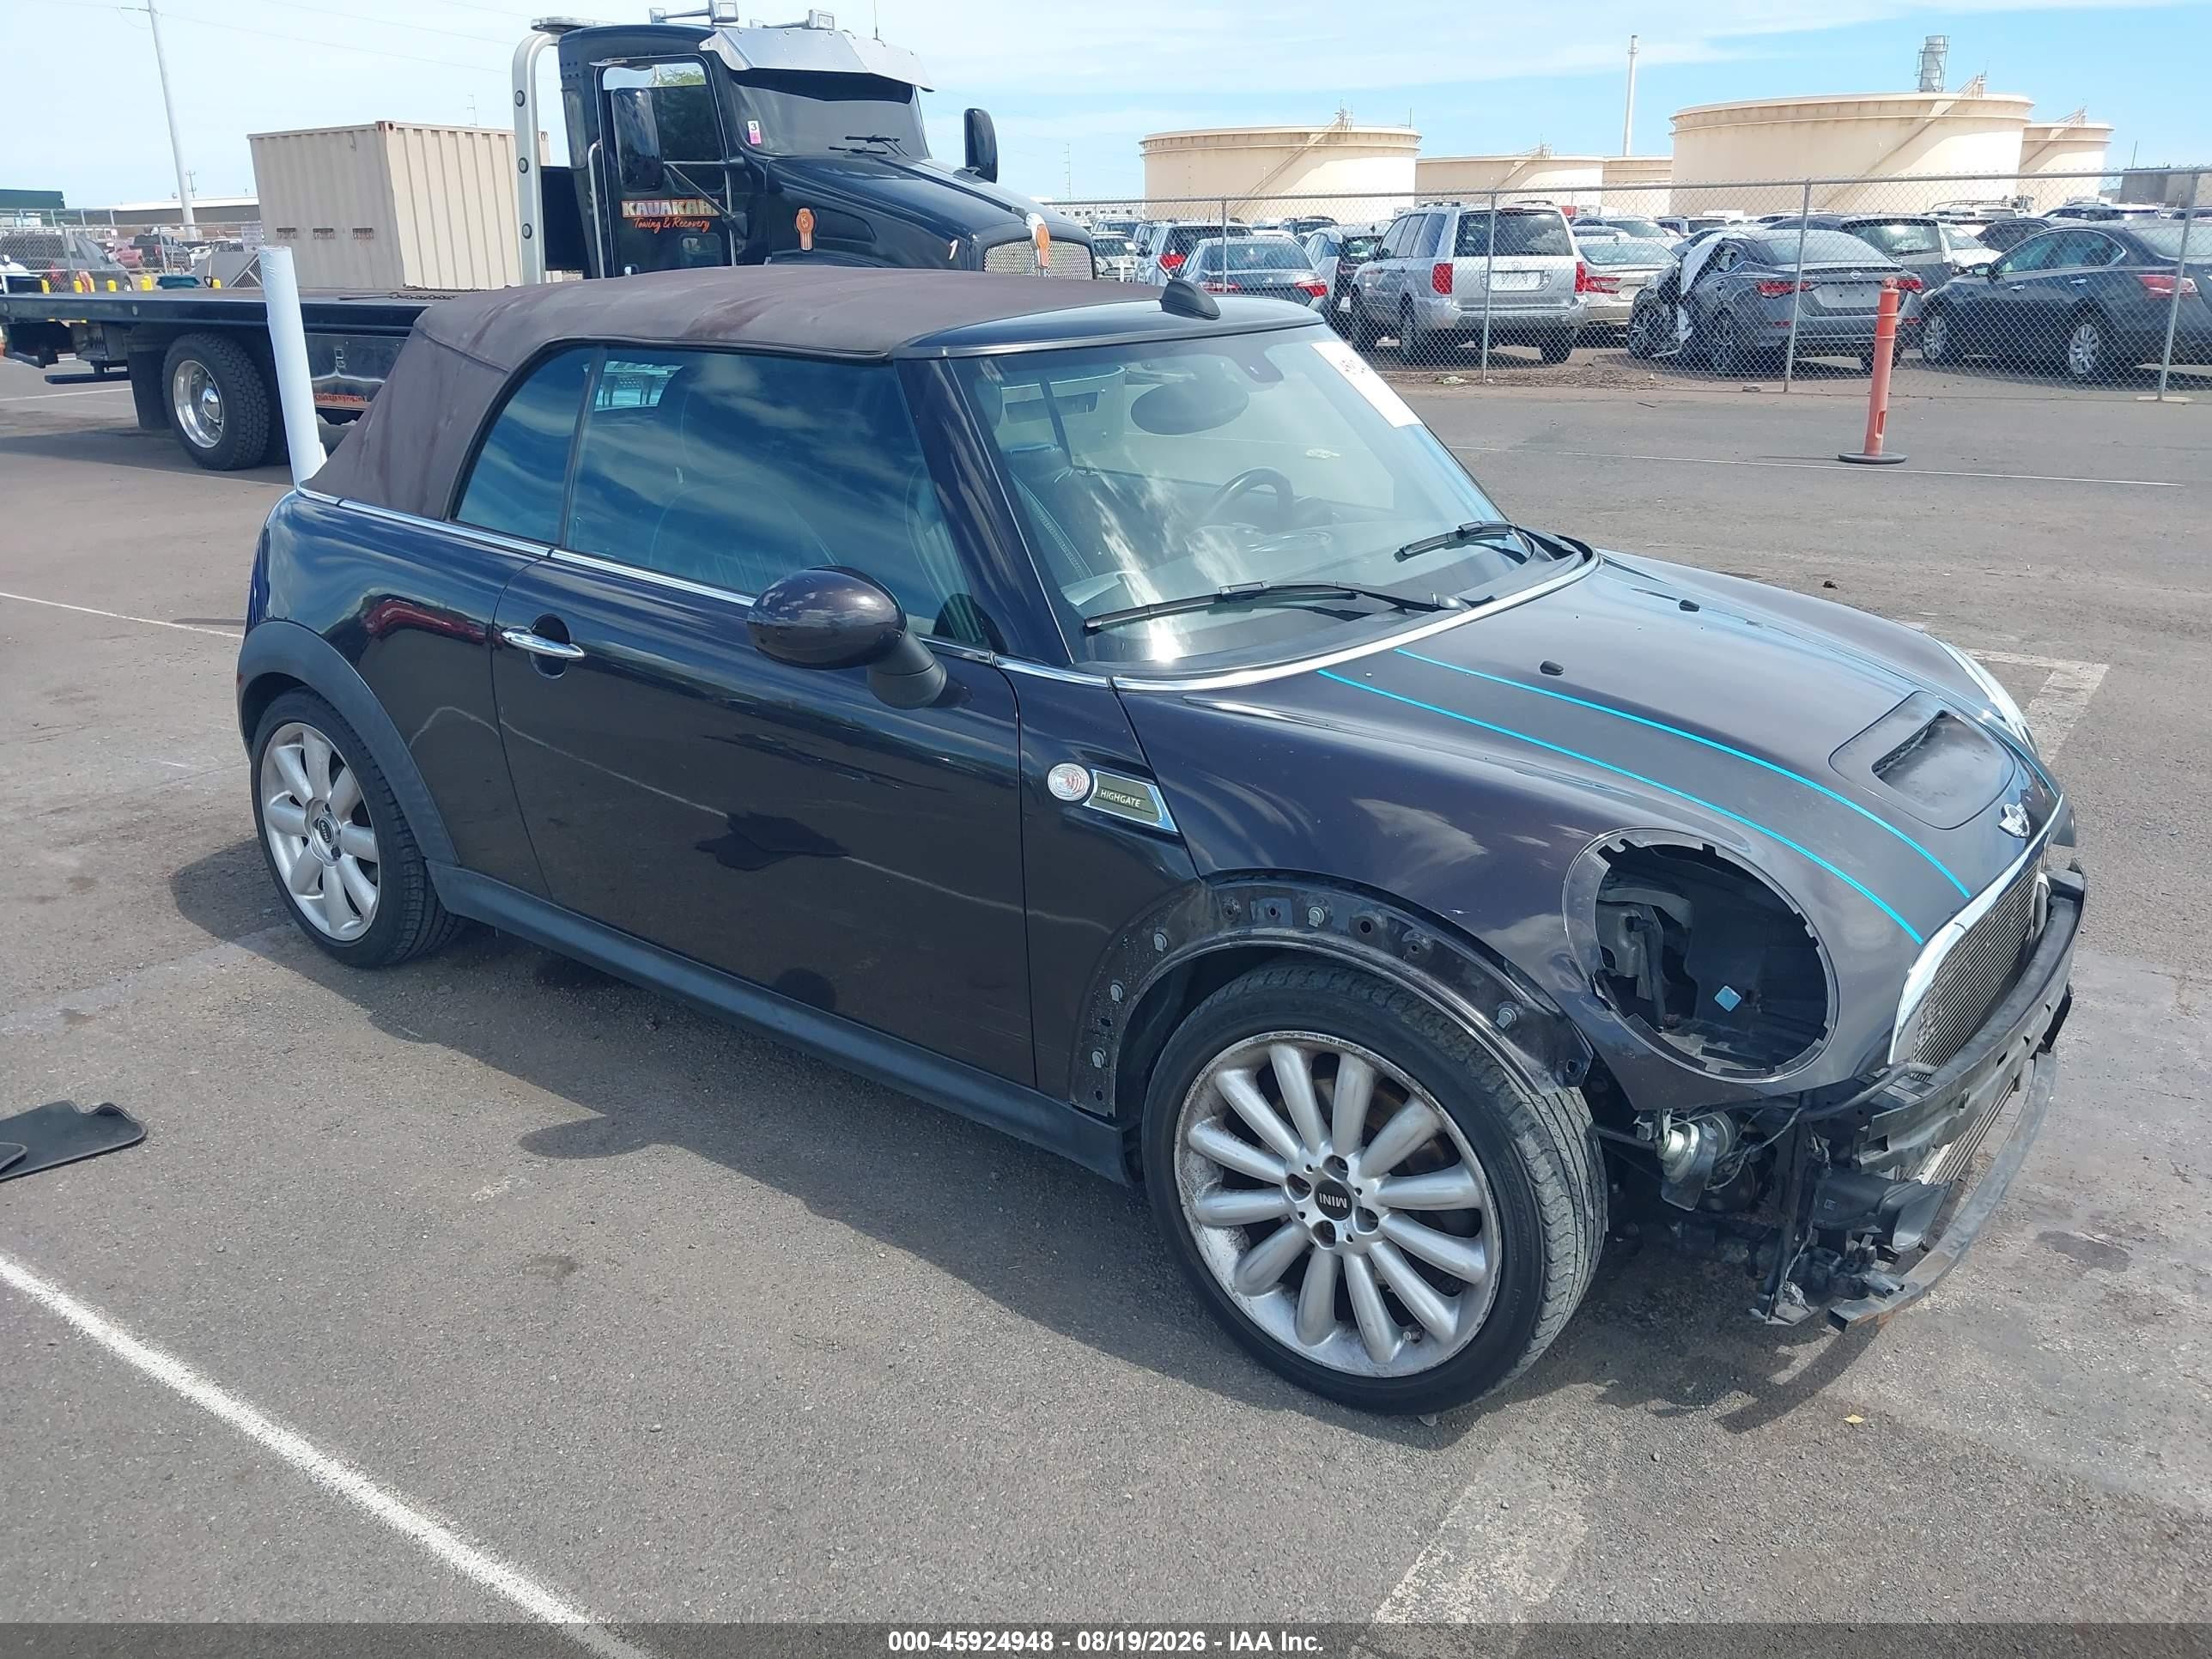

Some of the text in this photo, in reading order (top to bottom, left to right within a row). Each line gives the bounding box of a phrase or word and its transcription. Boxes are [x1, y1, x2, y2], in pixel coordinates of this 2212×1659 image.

[750, 123, 757, 131] 3
[634, 216, 710, 234] Towing & Recovery
[948, 240, 959, 260] 1
[1100, 789, 1141, 808] HIGHGATE
[1318, 1192, 1348, 1210] MINI
